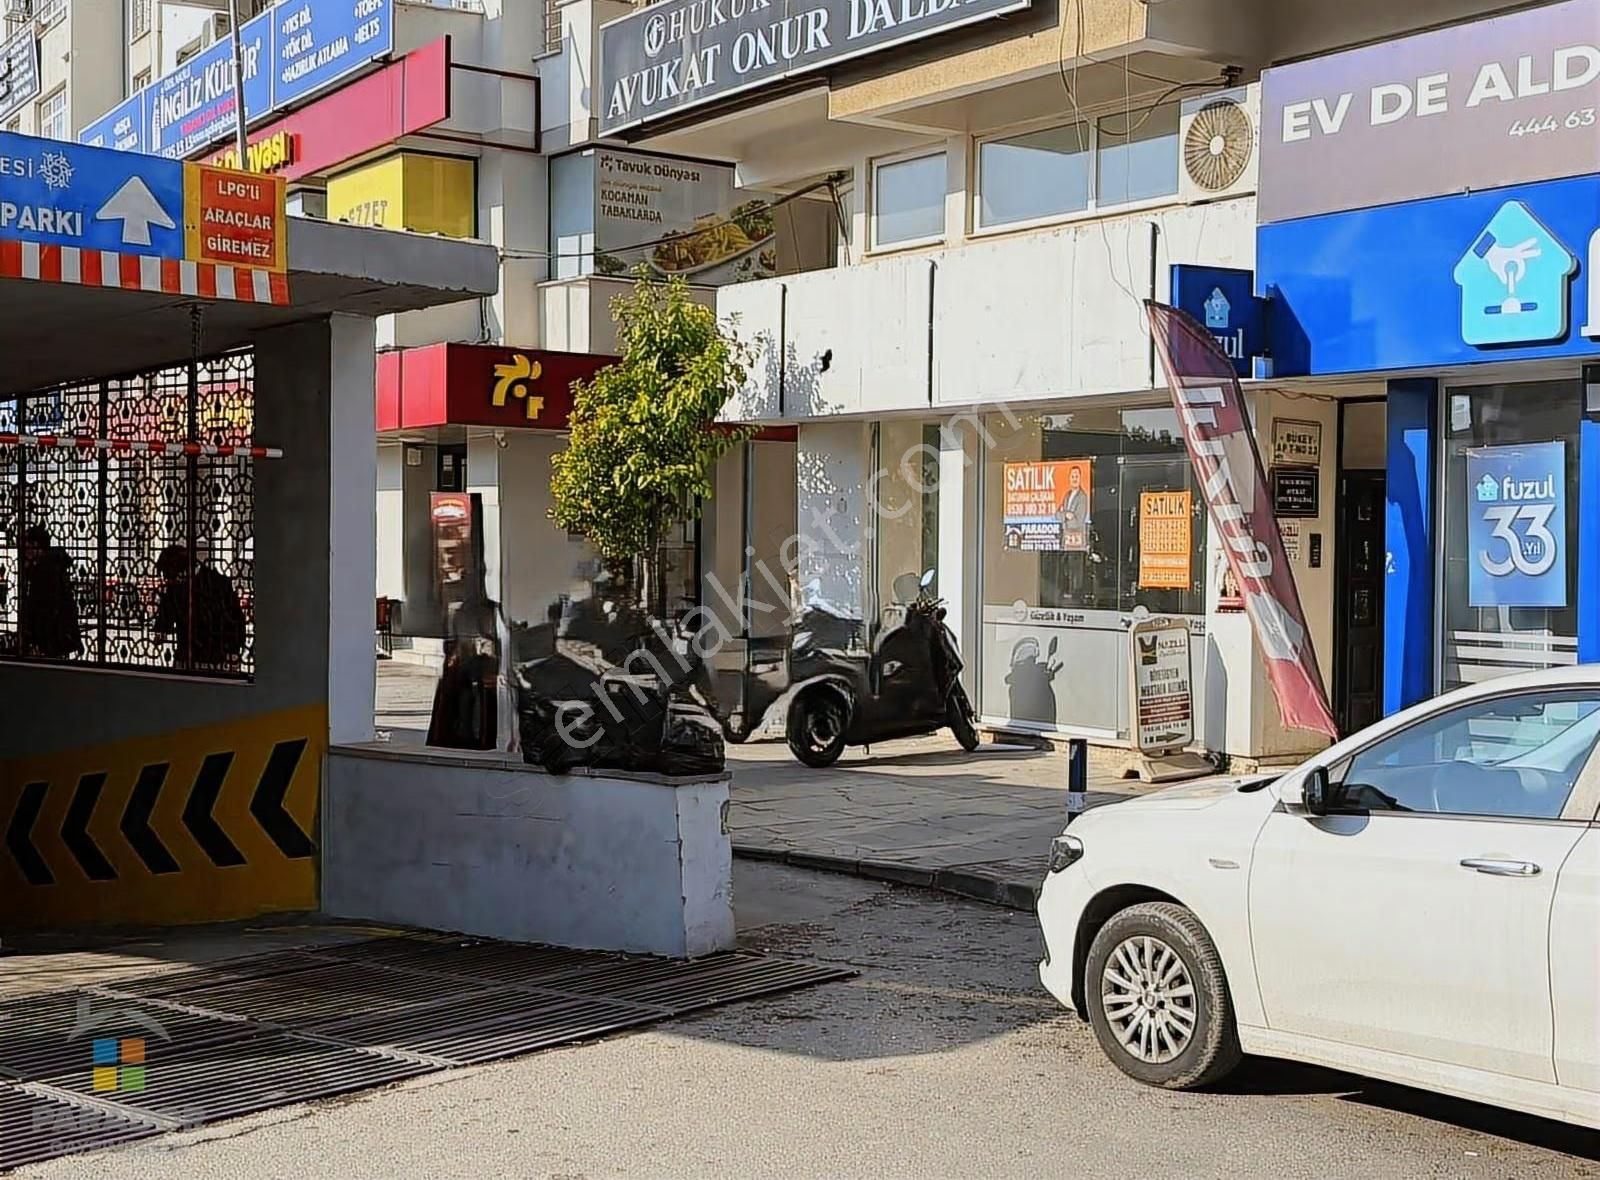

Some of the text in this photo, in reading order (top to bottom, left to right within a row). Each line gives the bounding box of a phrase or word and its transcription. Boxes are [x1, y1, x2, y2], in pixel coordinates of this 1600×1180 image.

[608, 44, 720, 119] AVUKAT
[732, 18, 830, 74] ONUR
[160, 75, 202, 129] İNGİLİZ
[1281, 45, 1600, 144] EV DE ALD
[1509, 107, 1595, 136] 444 63
[615, 160, 700, 182] Tavuk Dünyası
[601, 189, 648, 206] KOCAMAN
[1, 201, 82, 236] PARKI
[204, 207, 272, 231] ARAÇLAR
[601, 204, 662, 223] TABAKLARDA
[207, 233, 270, 258] GİREMEZ
[1007, 465, 1056, 491] SATILIK
[1502, 475, 1556, 501] fuzul
[1146, 495, 1185, 516] SATILIK
[1479, 503, 1557, 577] 33
